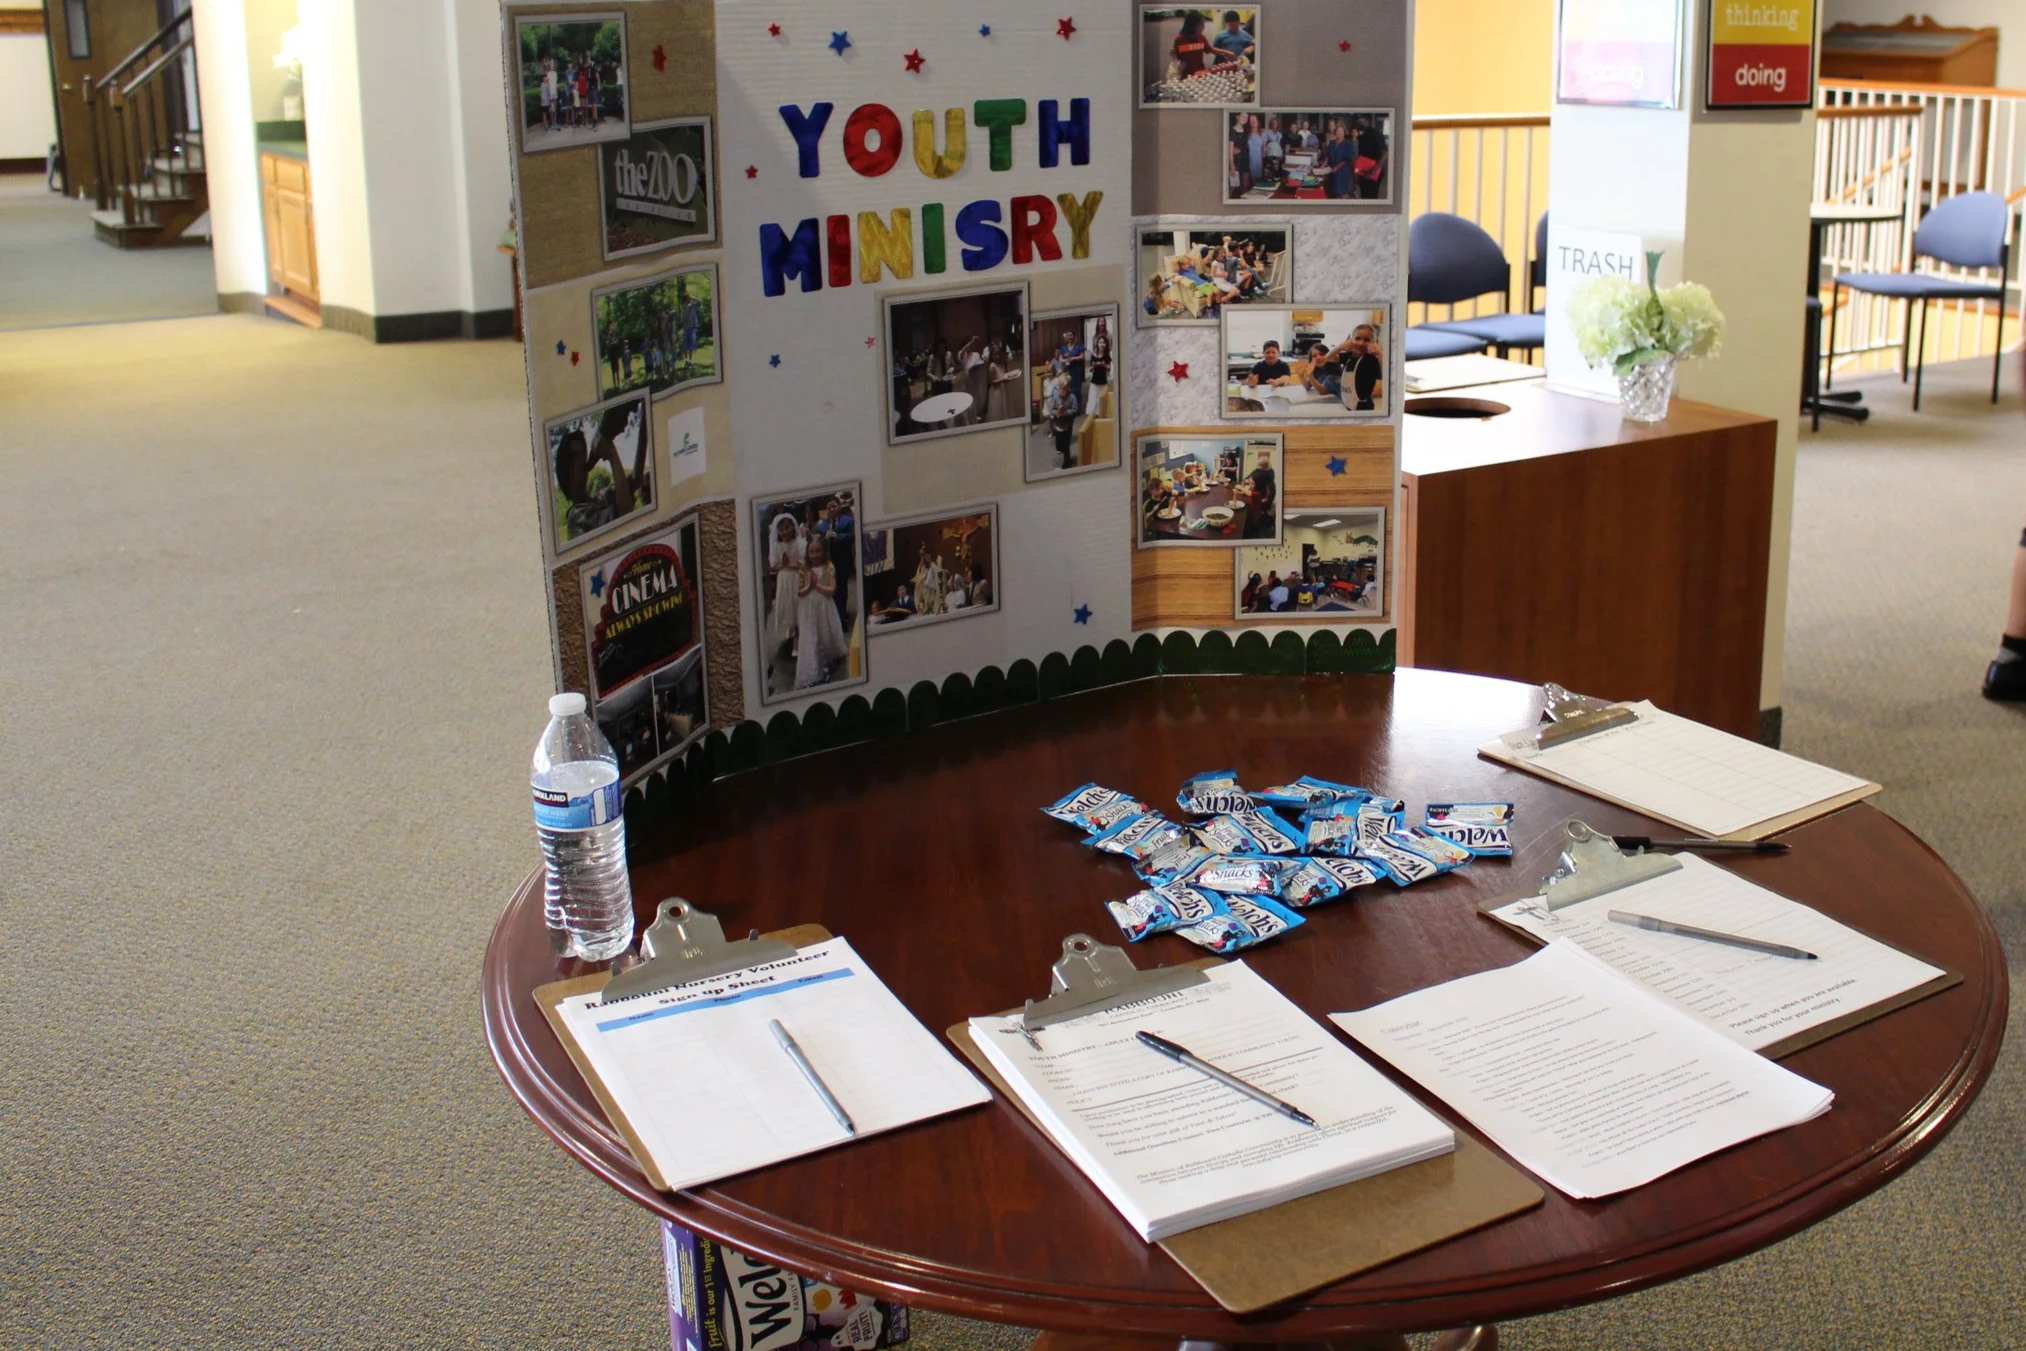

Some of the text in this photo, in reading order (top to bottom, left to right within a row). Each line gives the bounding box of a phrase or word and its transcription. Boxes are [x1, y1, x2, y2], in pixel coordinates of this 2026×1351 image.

[1725, 4, 1798, 31] thinking
[1735, 63, 1787, 92] doing
[779, 97, 1091, 180] YOUTH
[759, 190, 1104, 297] MINISRY
[1558, 245, 1633, 281] TRASH
[612, 564, 678, 615] CINEMA
[605, 611, 642, 639] ALWAYS
[1440, 825, 1508, 846] Welch
[1214, 866, 1253, 878] Snacks
[1325, 857, 1366, 884] elch's
[673, 971, 743, 991] Nursery
[746, 949, 831, 973] Volunteer
[658, 974, 777, 1005] Sign up Sheet
[700, 1238, 716, 1274] Ingredi
[707, 1289, 717, 1306] our
[704, 1317, 723, 1348] Fruit
[849, 1318, 862, 1344] REAL
